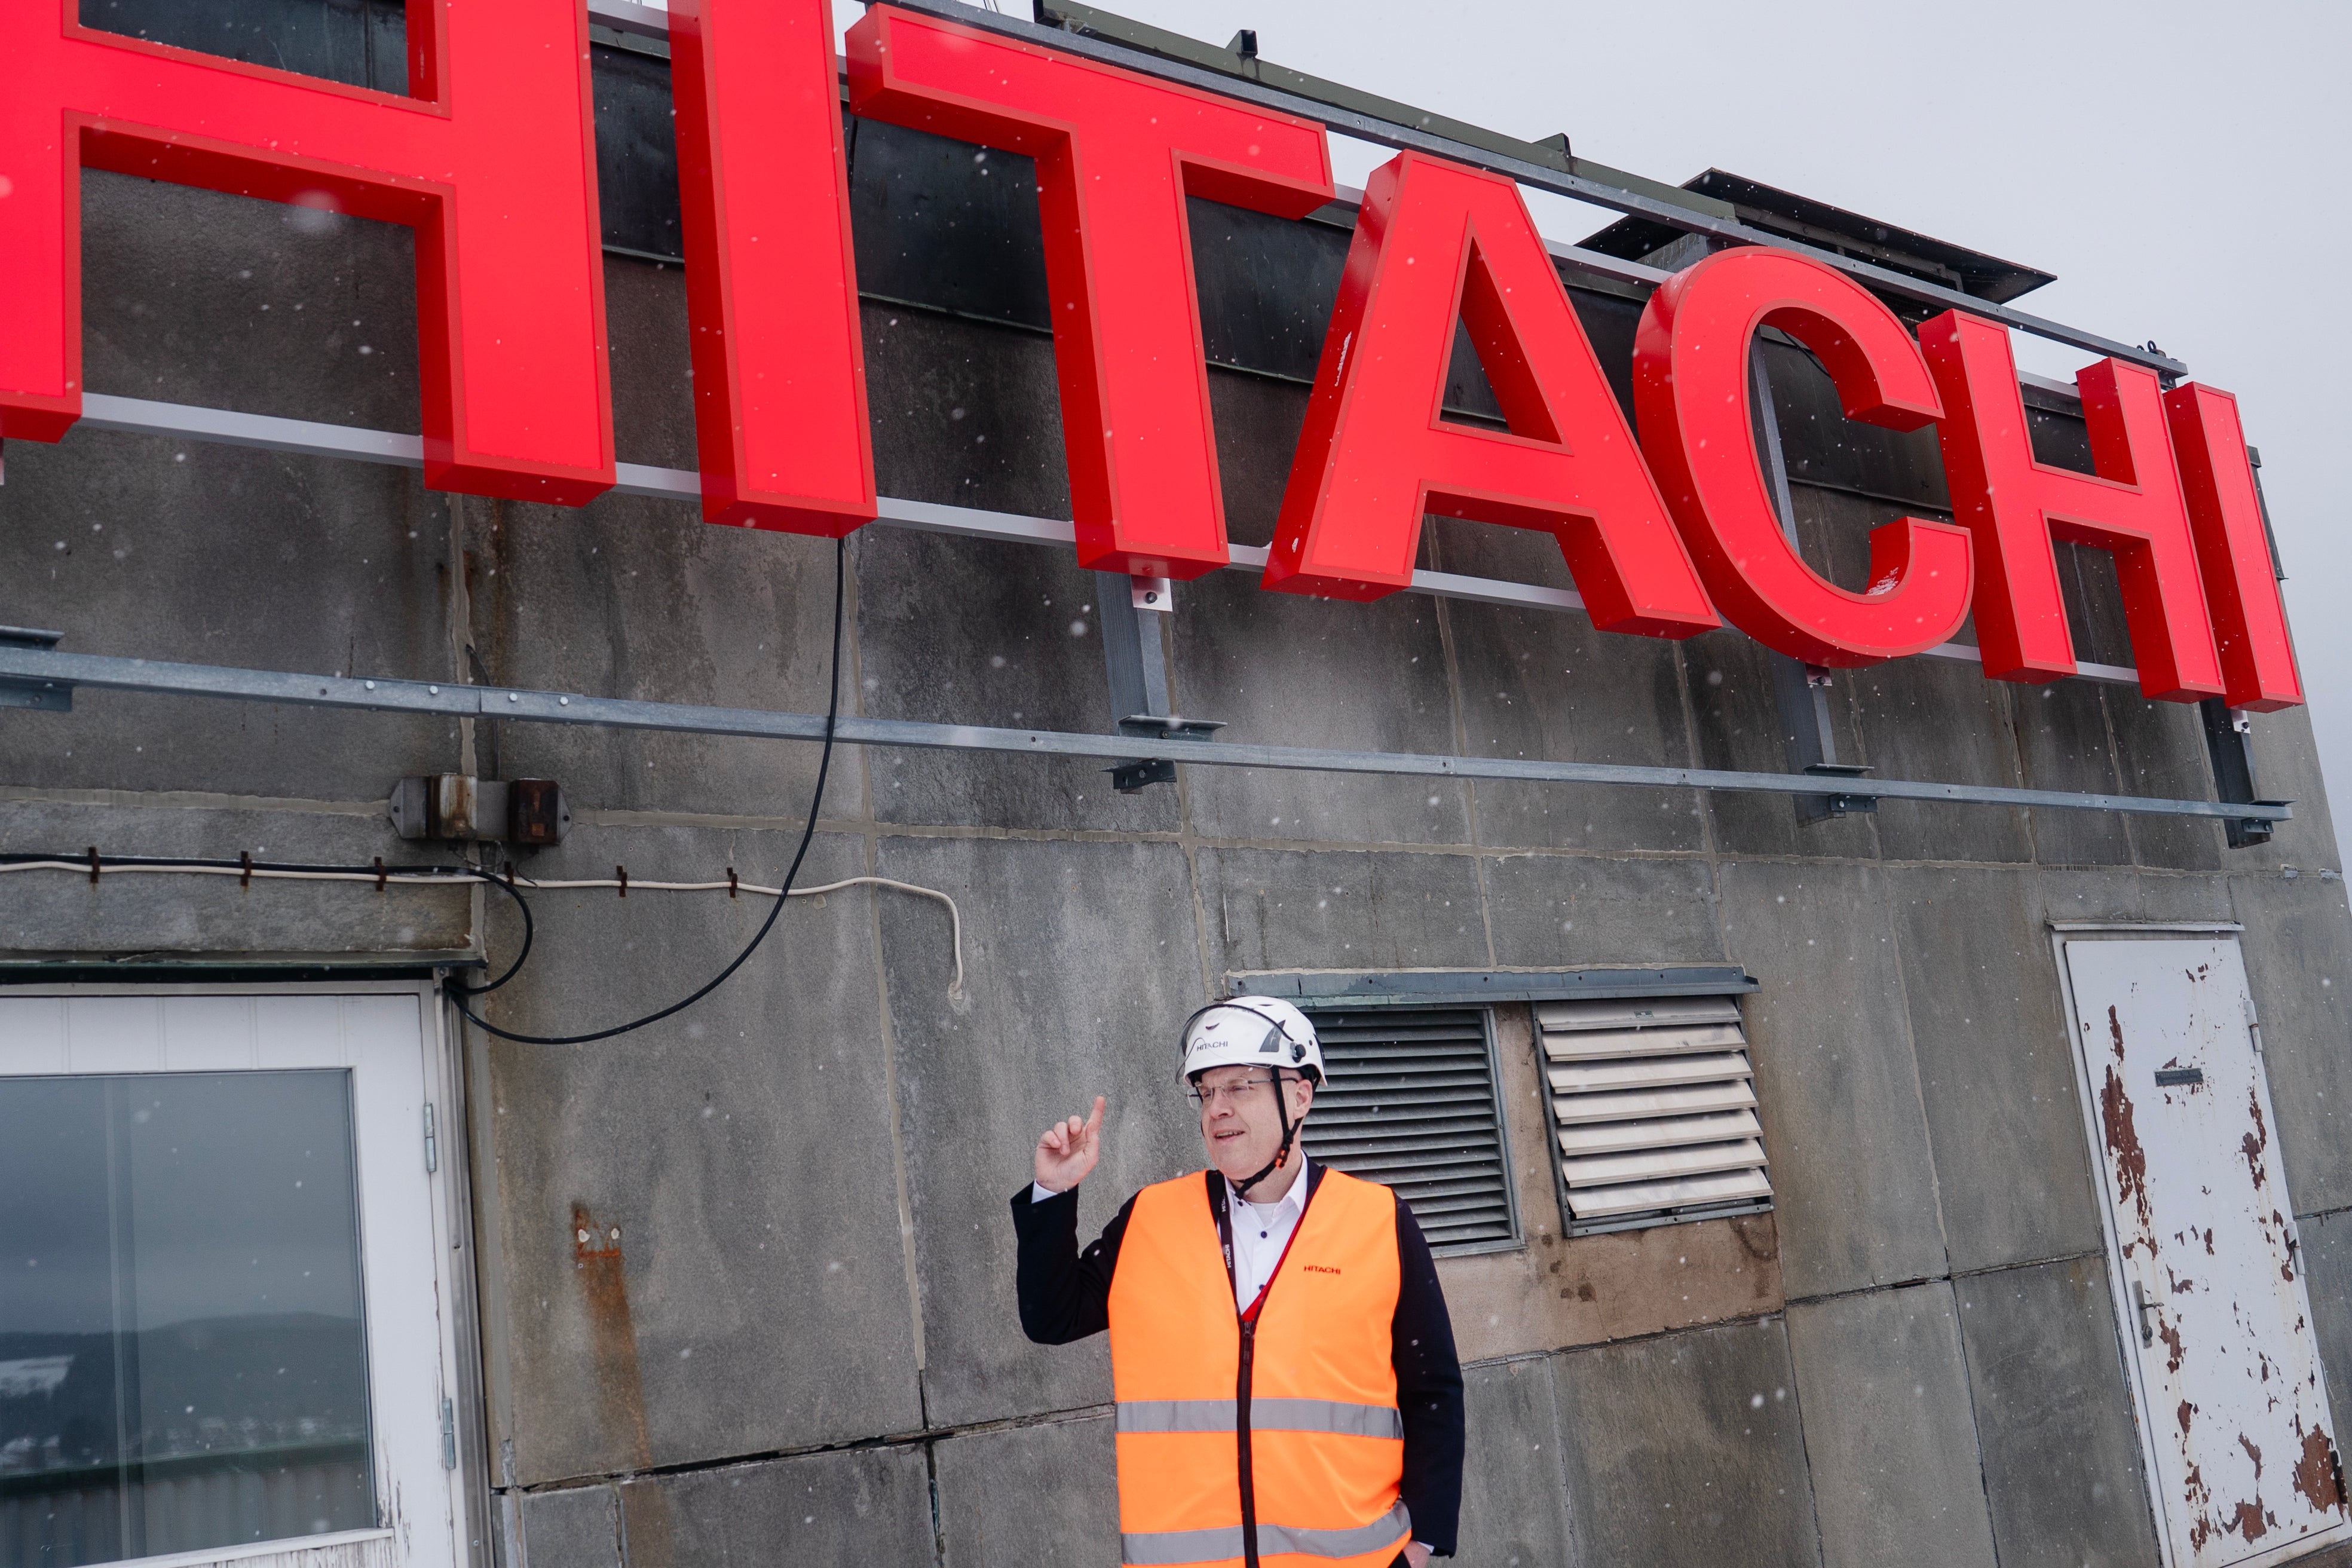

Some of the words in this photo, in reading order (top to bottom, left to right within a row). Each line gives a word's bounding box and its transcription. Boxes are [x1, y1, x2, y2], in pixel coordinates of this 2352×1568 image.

[0, 0, 2302, 712] HITACHI
[1197, 1040, 1229, 1052] HITACHI
[1304, 1265, 1340, 1275] HITACHI
